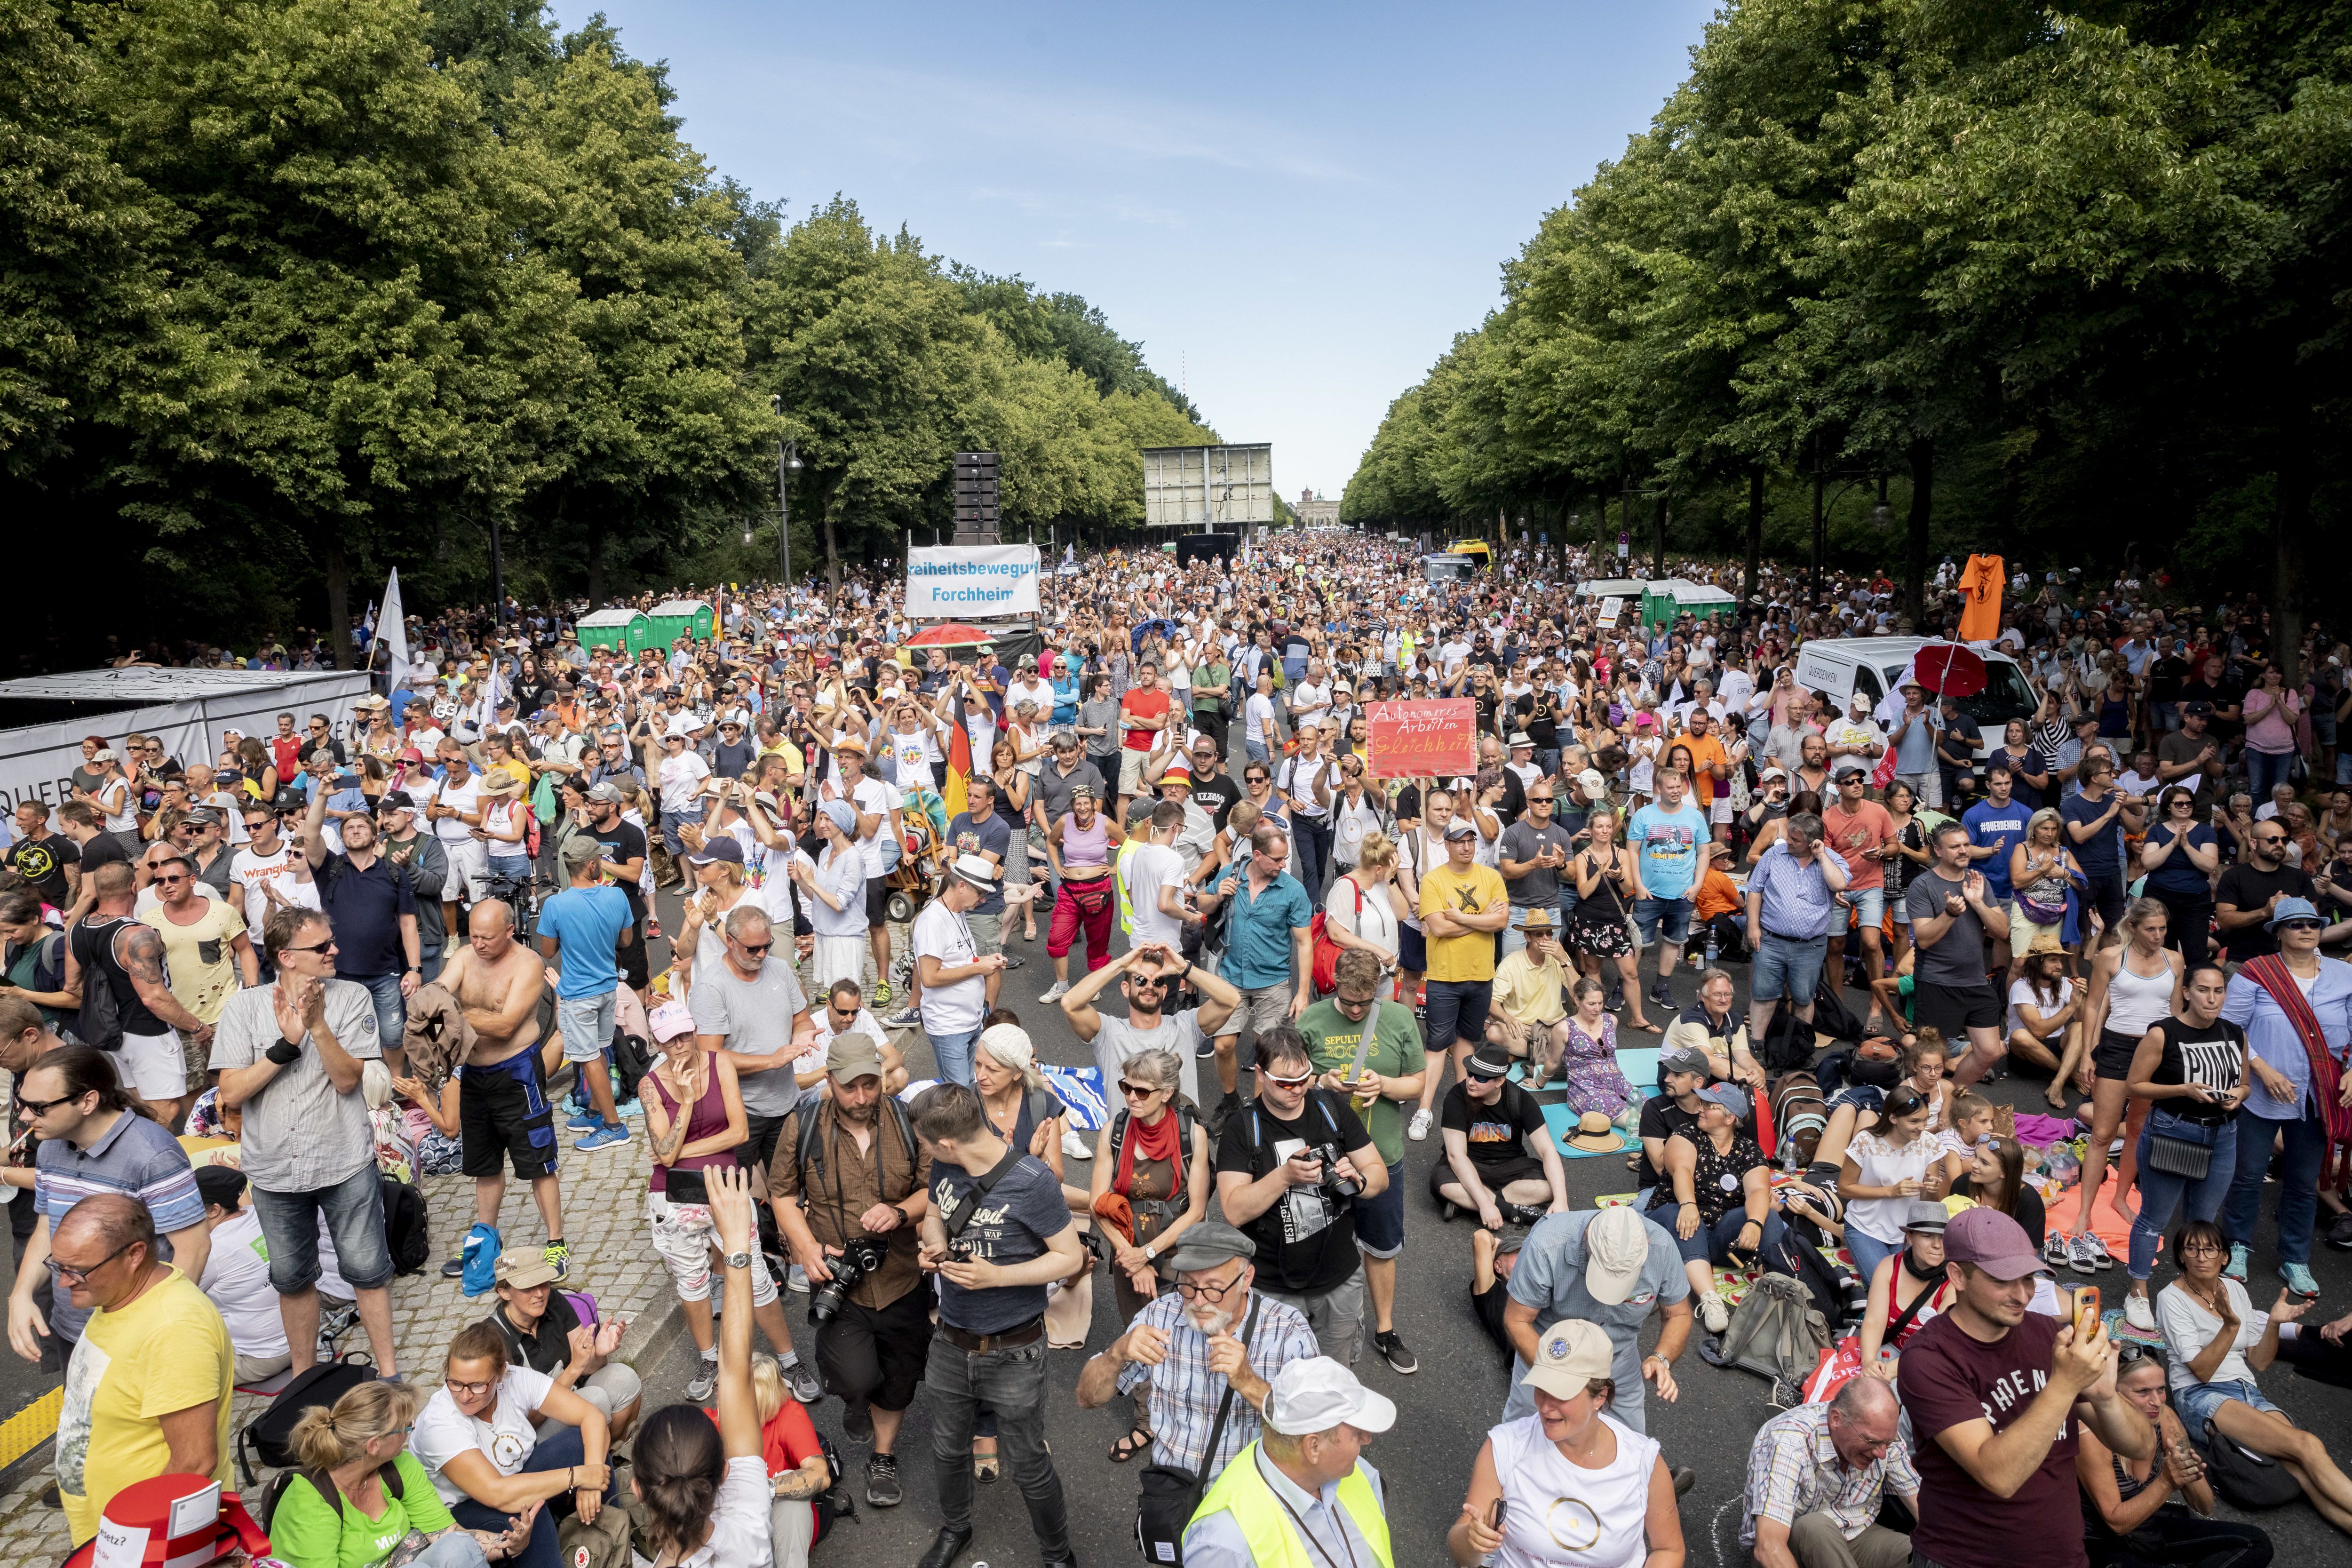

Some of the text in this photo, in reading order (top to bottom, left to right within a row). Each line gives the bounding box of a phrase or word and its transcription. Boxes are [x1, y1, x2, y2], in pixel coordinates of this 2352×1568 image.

[932, 588, 1014, 601] Forchheim
[1809, 666, 1837, 684] QUERDENKEN
[1980, 820, 2022, 832] #QUERDENKER
[244, 863, 288, 880] Wrangle
[1325, 1035, 1378, 1045] SEPULTUA
[1325, 1041, 1379, 1059] ROOS
[2185, 1045, 2241, 1091] PUMA
[1285, 1224, 1295, 1243] WEST
[374, 1528, 402, 1551] Mut
[1517, 1546, 1544, 1563] erkennen
